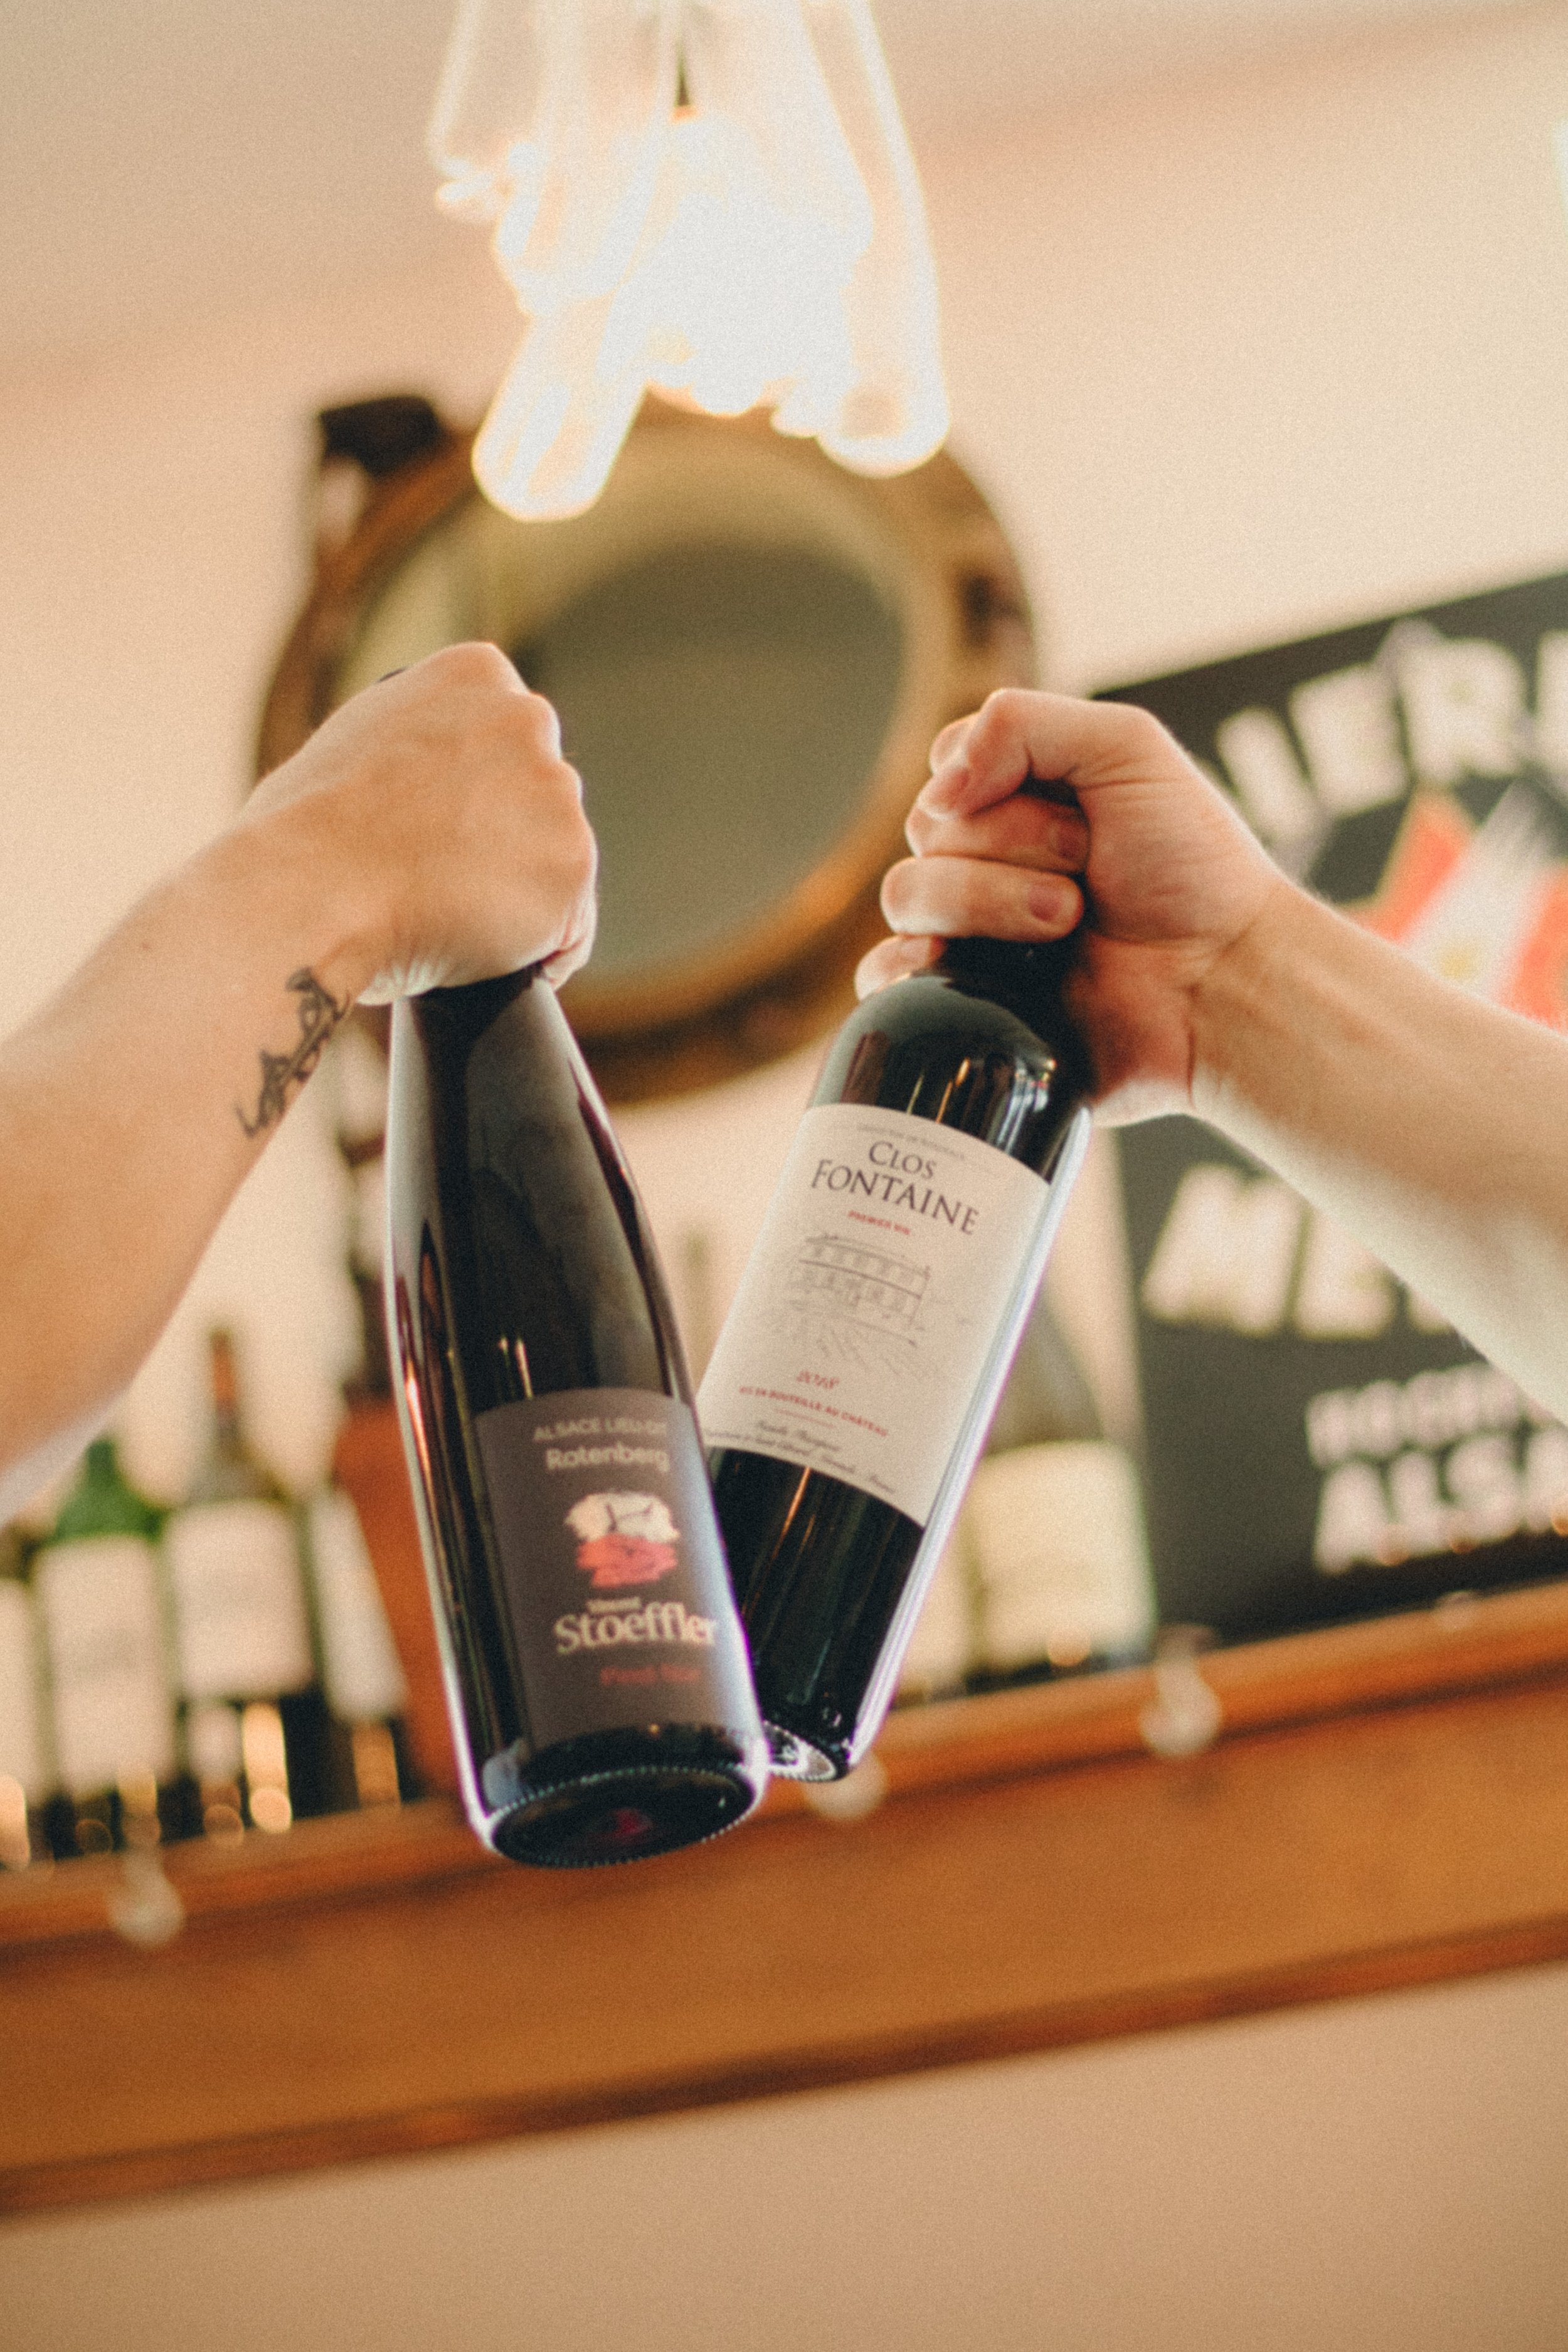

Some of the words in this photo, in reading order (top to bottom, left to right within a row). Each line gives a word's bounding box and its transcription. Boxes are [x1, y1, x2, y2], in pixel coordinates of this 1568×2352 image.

[869, 1140, 937, 1179] CLOS
[811, 1158, 980, 1236] FONTAINE
[533, 1417, 600, 1441] ALSACE
[546, 1441, 671, 1474] Rotenberg
[554, 1601, 720, 1654] Stoeffler
